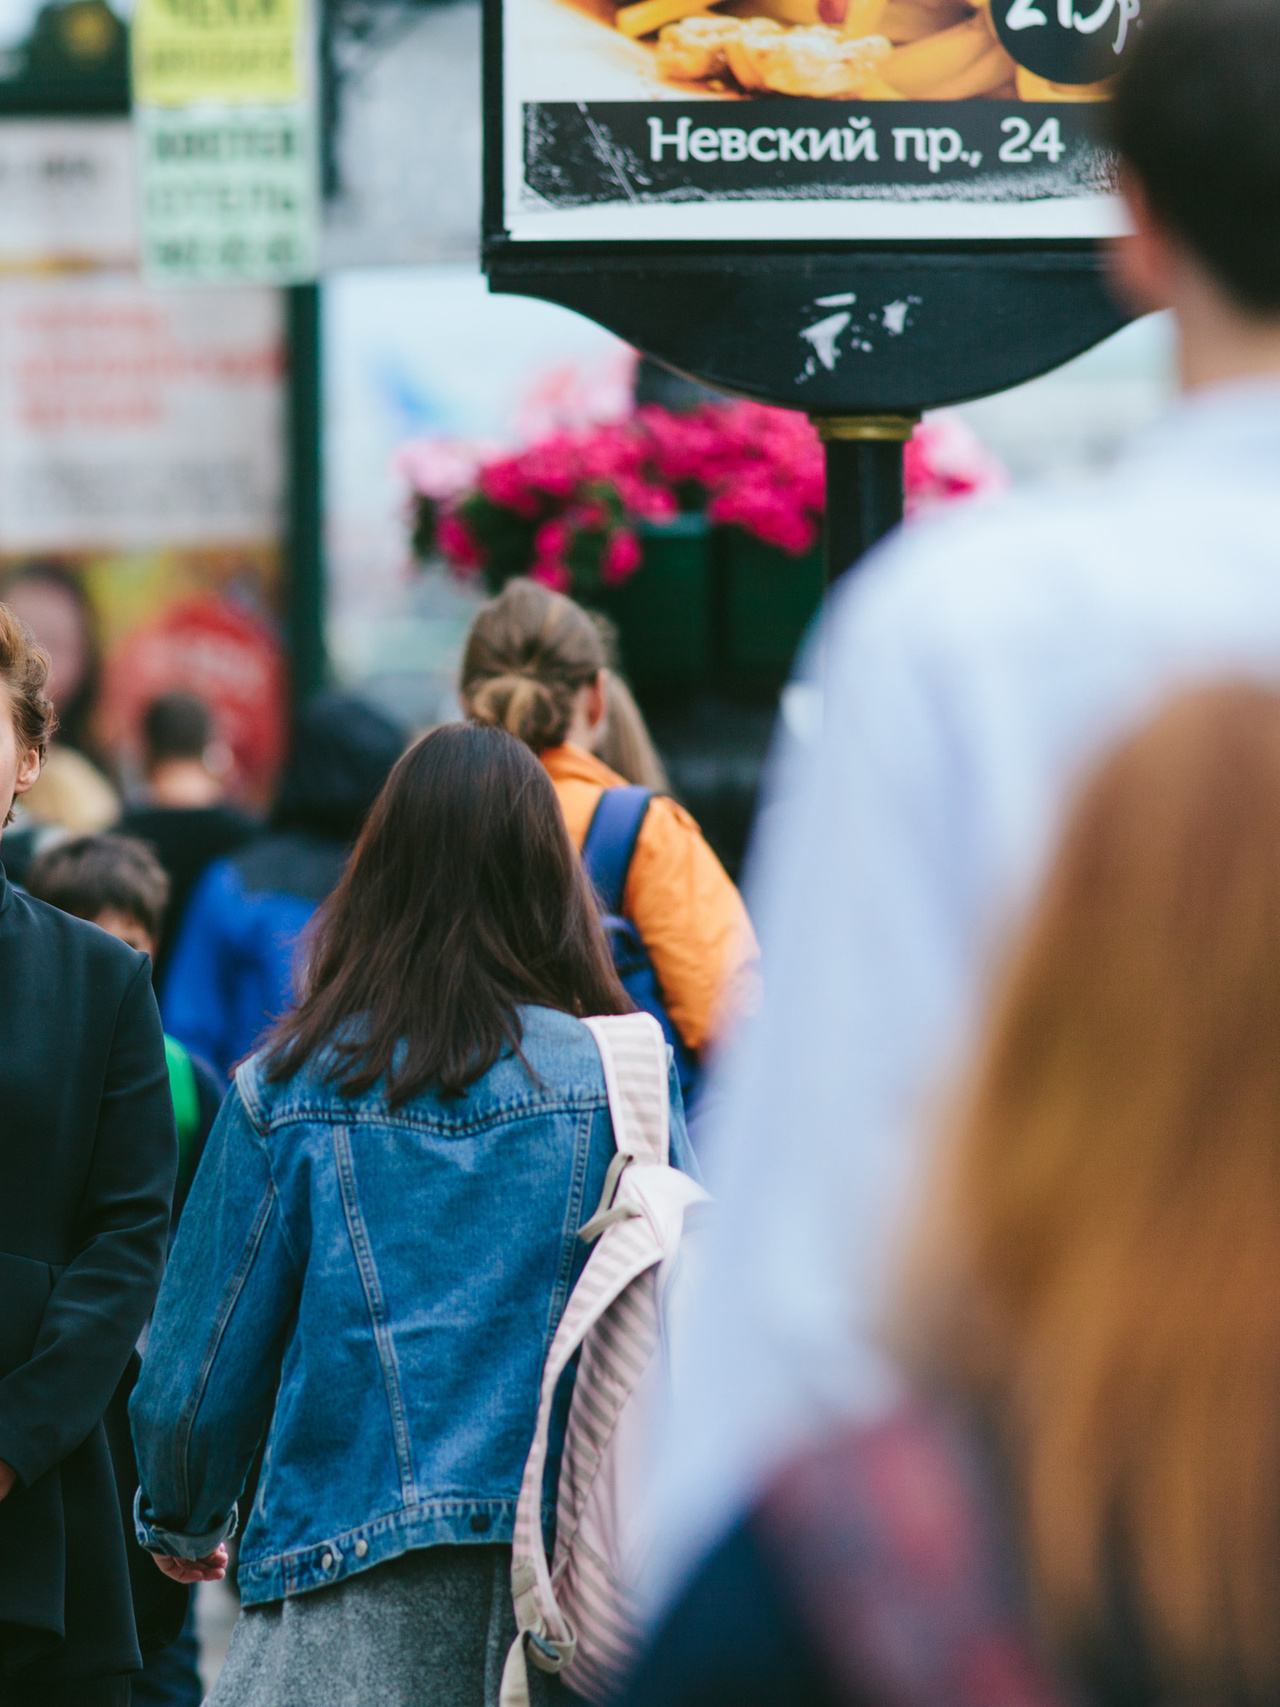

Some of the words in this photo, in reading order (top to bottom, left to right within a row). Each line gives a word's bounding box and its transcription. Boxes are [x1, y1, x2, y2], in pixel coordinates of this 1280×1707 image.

[647, 116, 879, 162] Невский
[891, 126, 982, 173] пр.,
[998, 117, 1066, 163] 24
